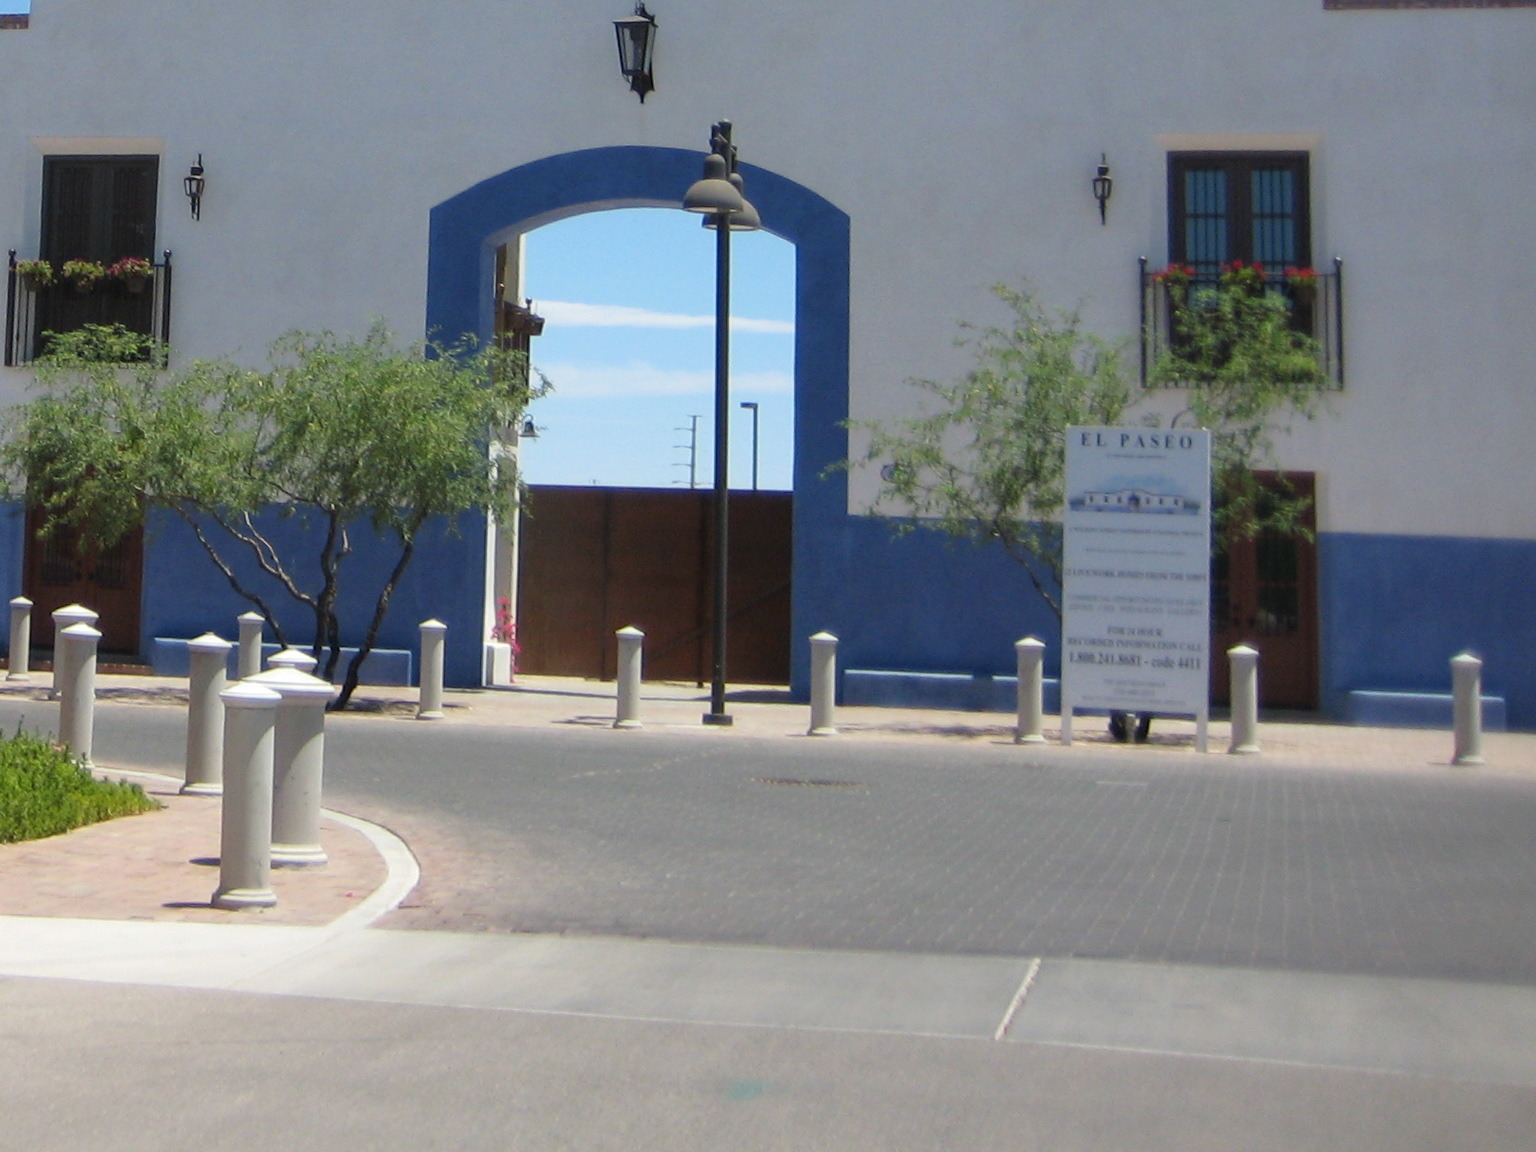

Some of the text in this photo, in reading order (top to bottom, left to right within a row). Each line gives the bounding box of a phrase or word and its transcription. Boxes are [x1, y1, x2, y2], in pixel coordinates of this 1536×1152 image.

[1081, 432, 1193, 449] EL PASEO
[1107, 625, 1125, 635] FOR
[1137, 627, 1162, 637] HOUR
[1116, 638, 1178, 650] INFORMATION
[1179, 641, 1202, 651] CALL
[1151, 656, 1175, 669] code
